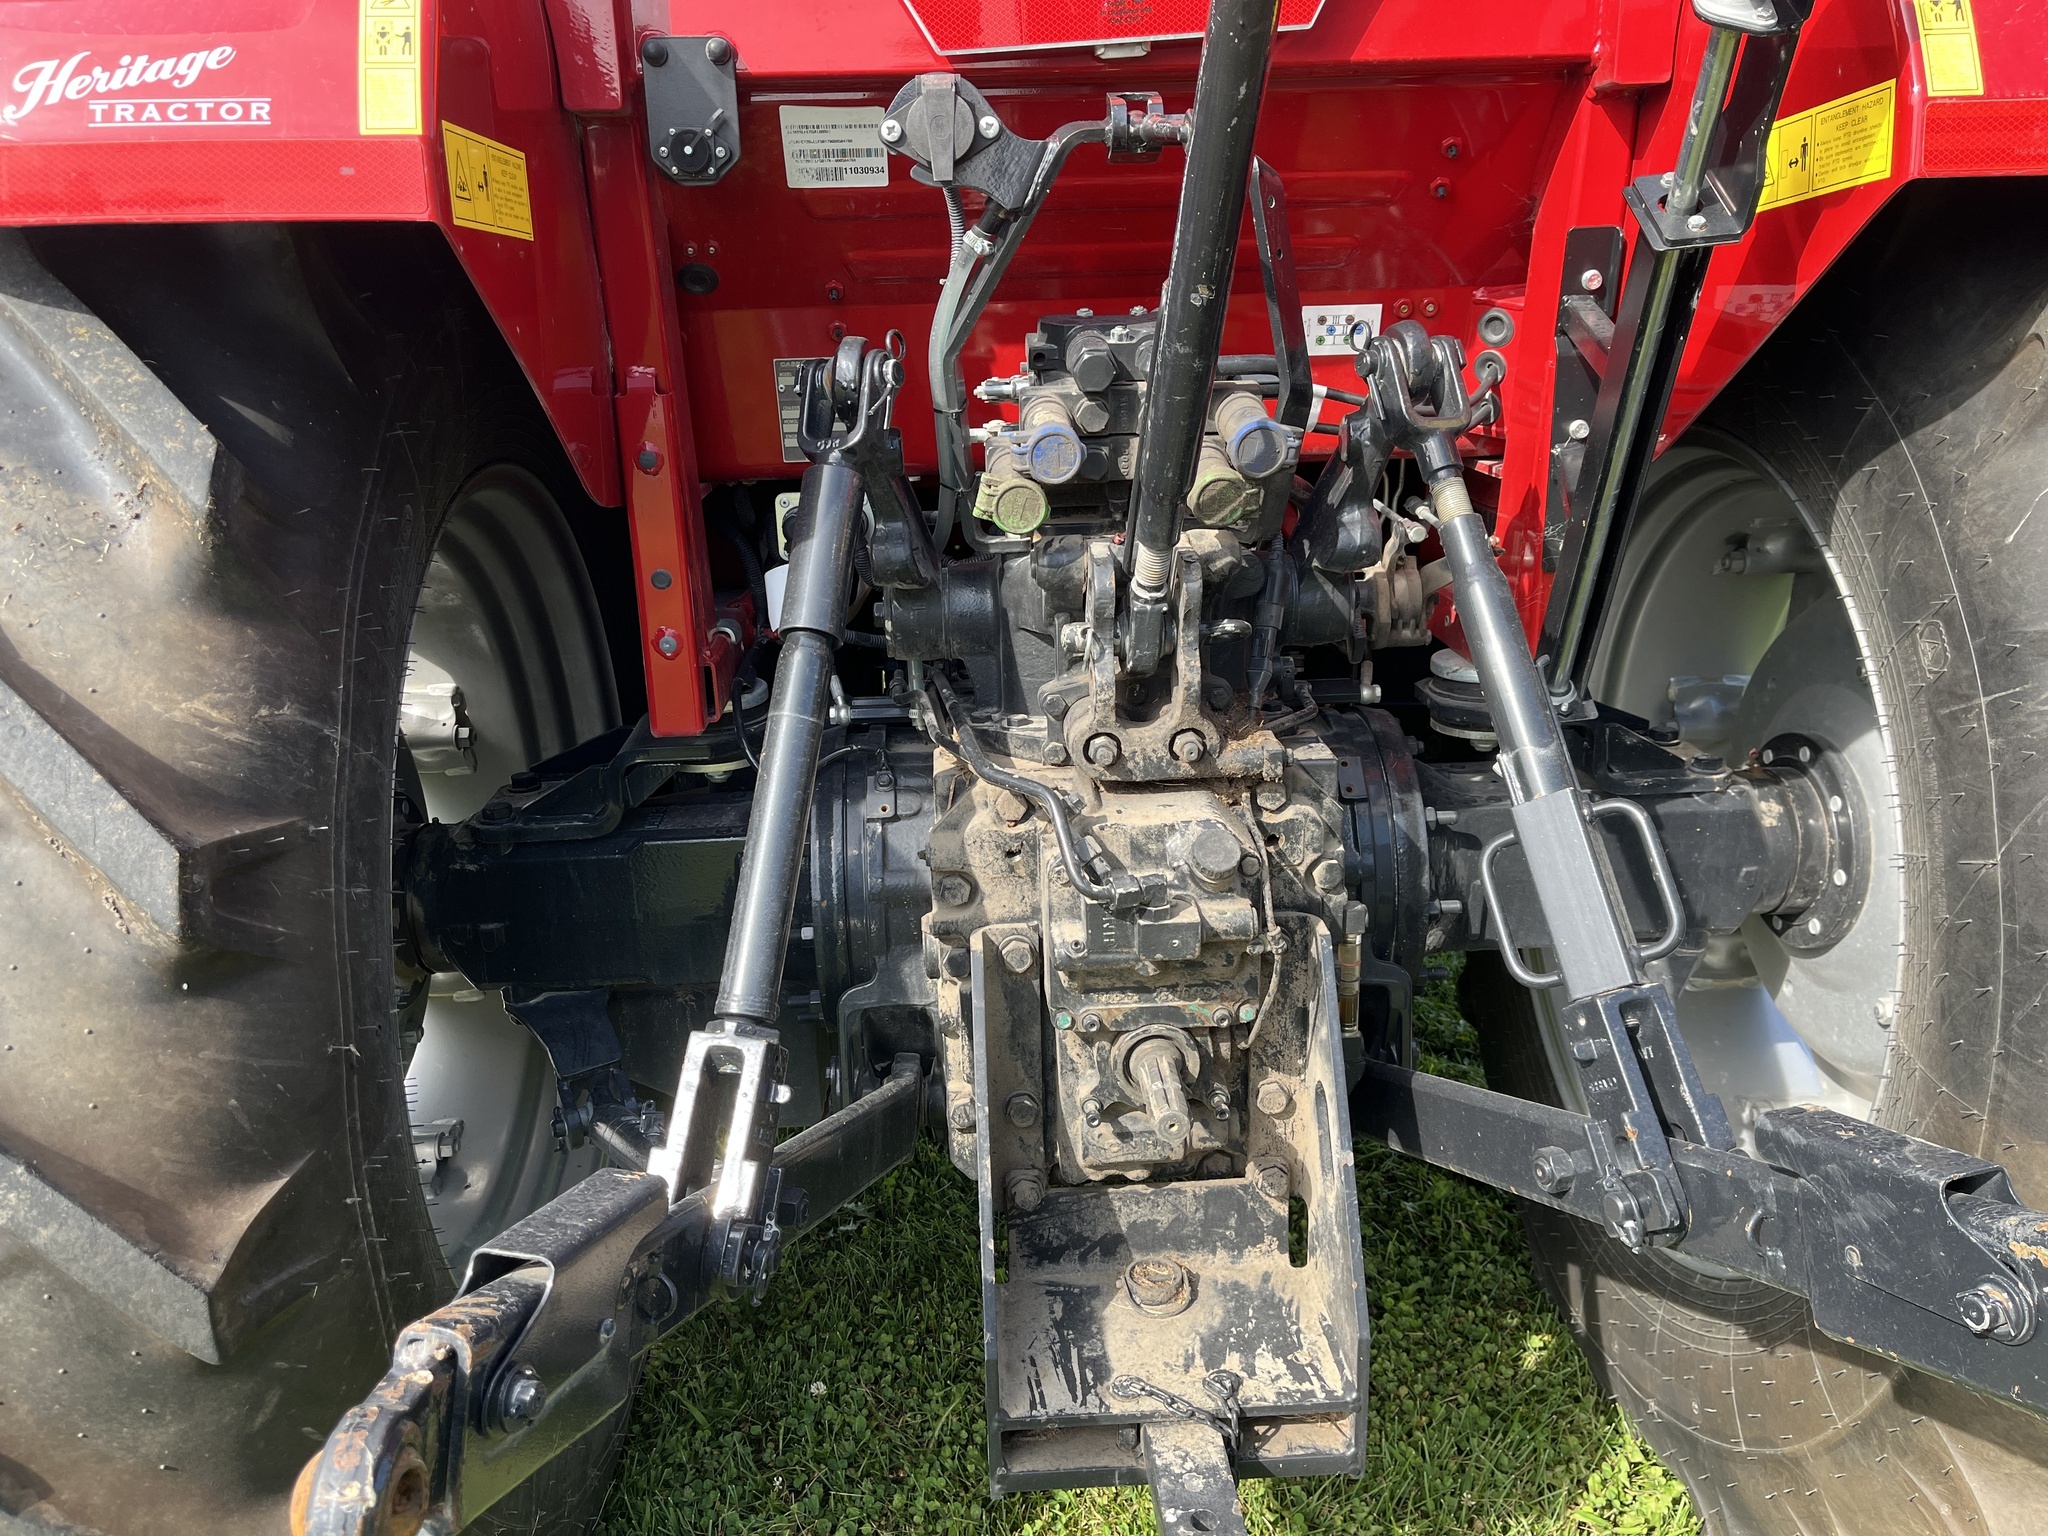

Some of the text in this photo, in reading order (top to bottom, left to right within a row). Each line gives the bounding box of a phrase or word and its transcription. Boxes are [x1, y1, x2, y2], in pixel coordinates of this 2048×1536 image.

[3, 45, 236, 119] Heritage
[89, 102, 271, 122] TRACTOR
[1821, 97, 1884, 125] ENTANGLEMENT HAZARD
[1836, 115, 1868, 131] KEEP CLEAR
[844, 166, 885, 174] 11030934
